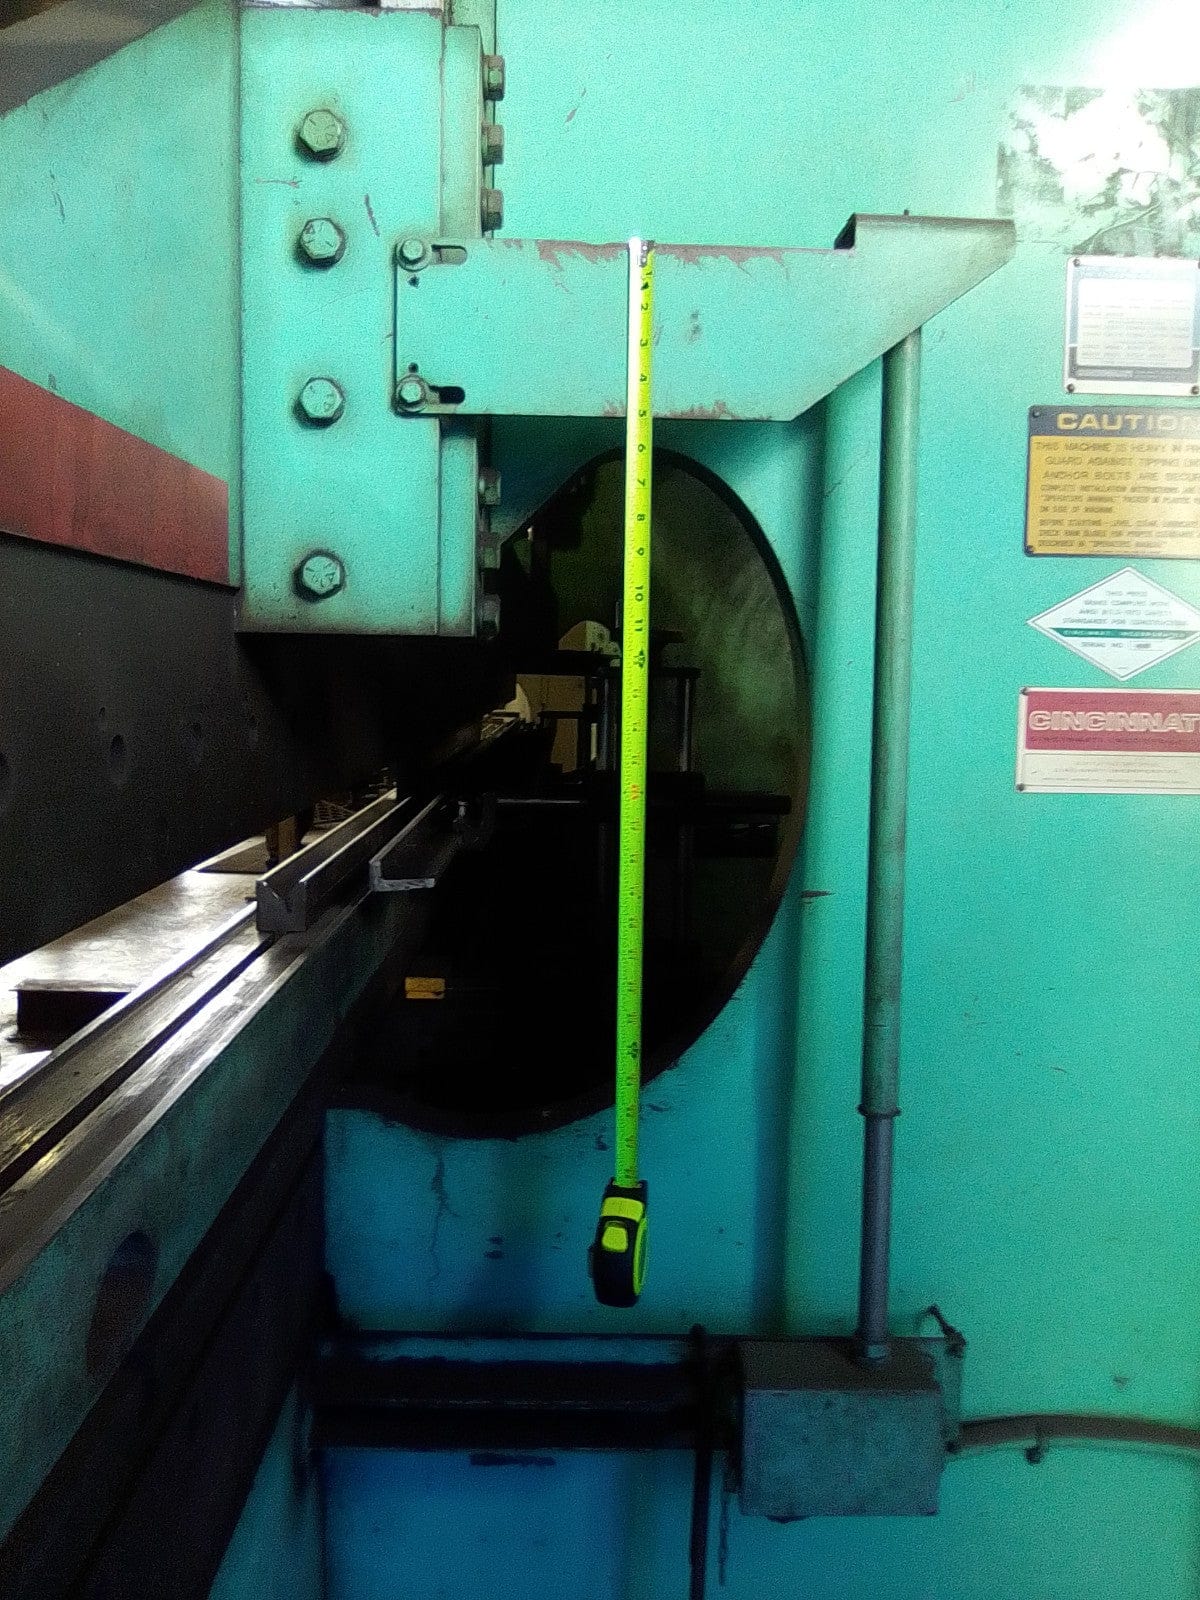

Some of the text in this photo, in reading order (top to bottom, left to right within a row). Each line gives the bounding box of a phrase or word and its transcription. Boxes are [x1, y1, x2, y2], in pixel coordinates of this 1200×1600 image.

[1044, 456, 1083, 466] GUARD
[1087, 457, 1133, 466] AGAINST
[1042, 471, 1089, 480] ANCHOR
[1094, 471, 1132, 481] BOLTS
[637, 478, 646, 488] 7
[636, 513, 645, 522] 8
[636, 547, 645, 556] 9
[635, 585, 644, 602] 10
[634, 618, 644, 632] 11
